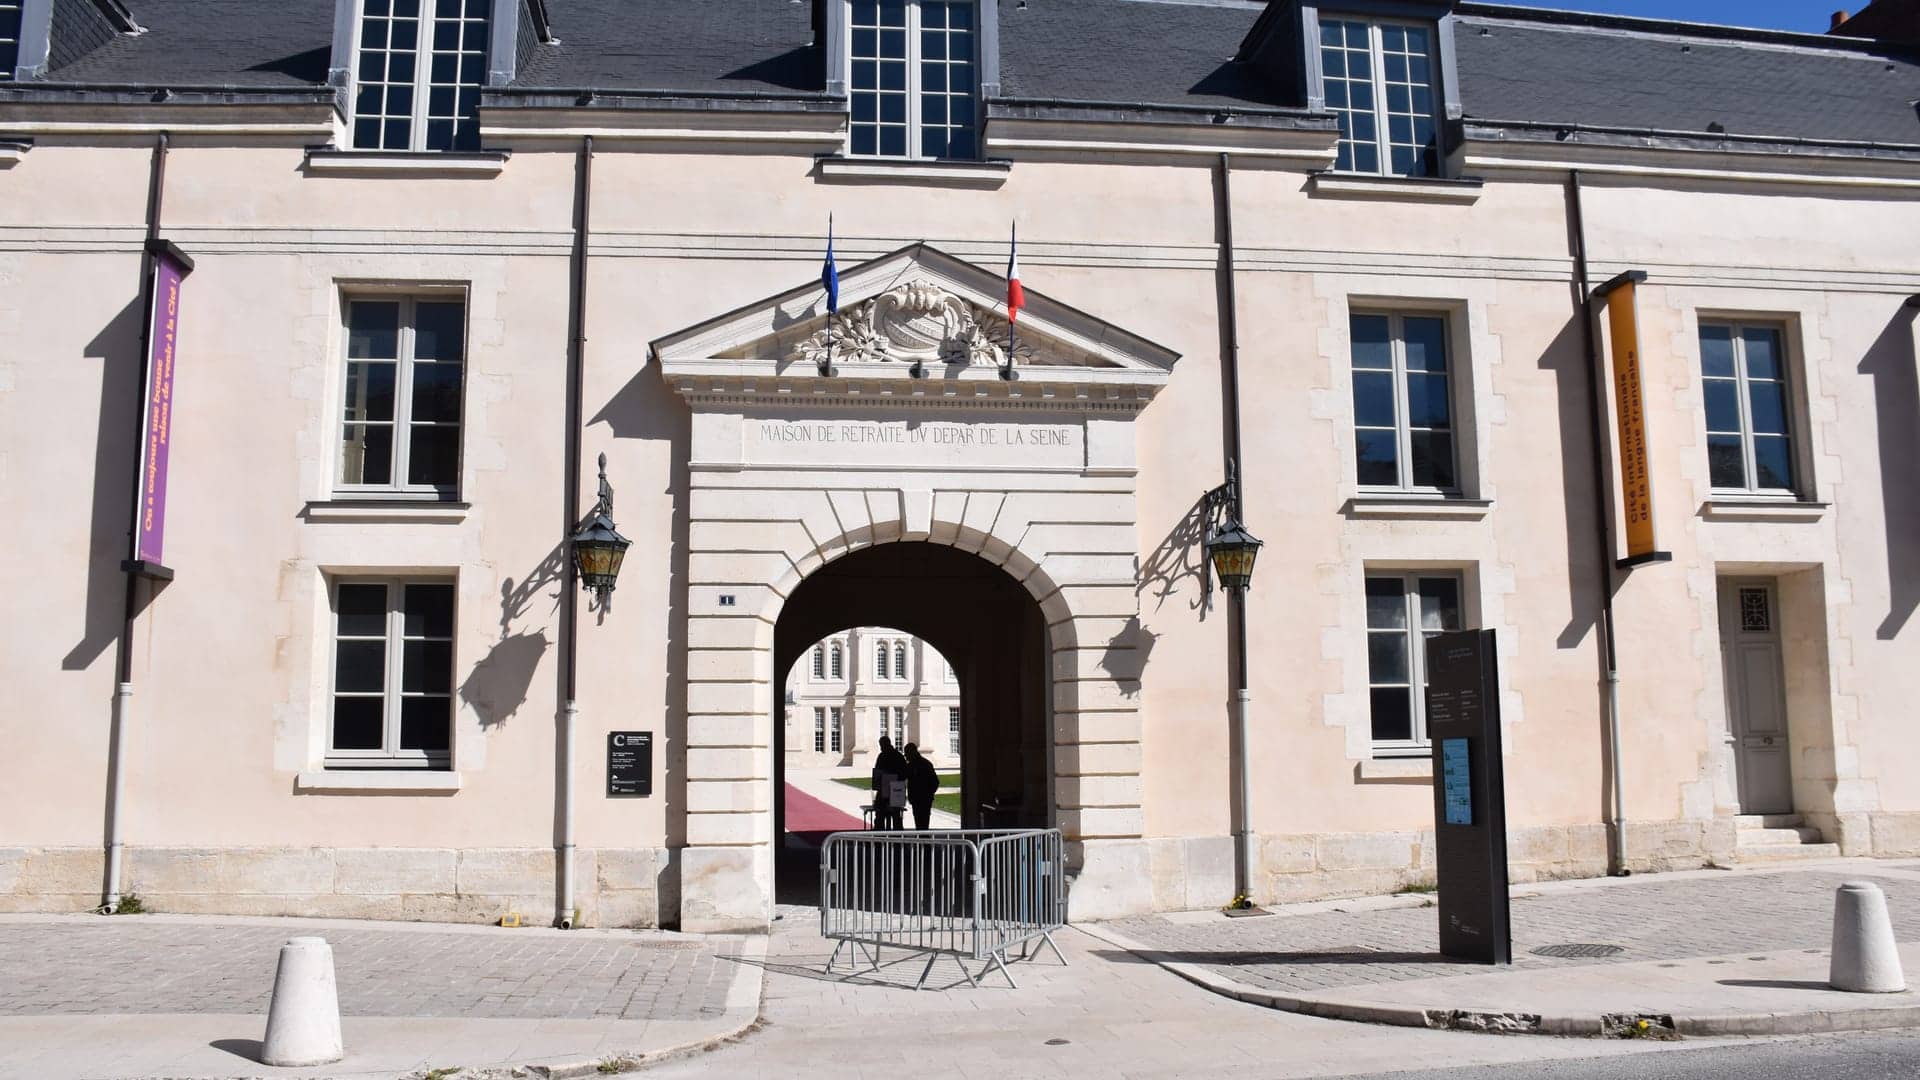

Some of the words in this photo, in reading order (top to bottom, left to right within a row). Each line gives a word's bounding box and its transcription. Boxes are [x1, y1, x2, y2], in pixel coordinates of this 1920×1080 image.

[168, 287, 177, 316] Cité
[166, 333, 174, 342] à
[167, 319, 175, 331] la
[164, 343, 173, 379] venir
[154, 358, 163, 404] bonne
[161, 382, 170, 400] de
[1628, 351, 1639, 424] française
[152, 406, 160, 433] une
[159, 401, 168, 444] raison
[1620, 374, 1635, 485] internationale
[761, 424, 811, 442] MAISON
[817, 425, 836, 443] DE
[841, 426, 905, 444] RETRAITE
[980, 428, 998, 445] DE
[1006, 428, 1023, 446] LA
[1030, 429, 1071, 446] SEINE
[147, 435, 158, 494] toujours
[1634, 429, 1644, 479] langue
[146, 497, 153, 506] a
[1638, 484, 1646, 497] la
[145, 508, 153, 532] On
[1628, 490, 1638, 524] Cité
[1639, 503, 1648, 521] de
[613, 734, 625, 747] C
